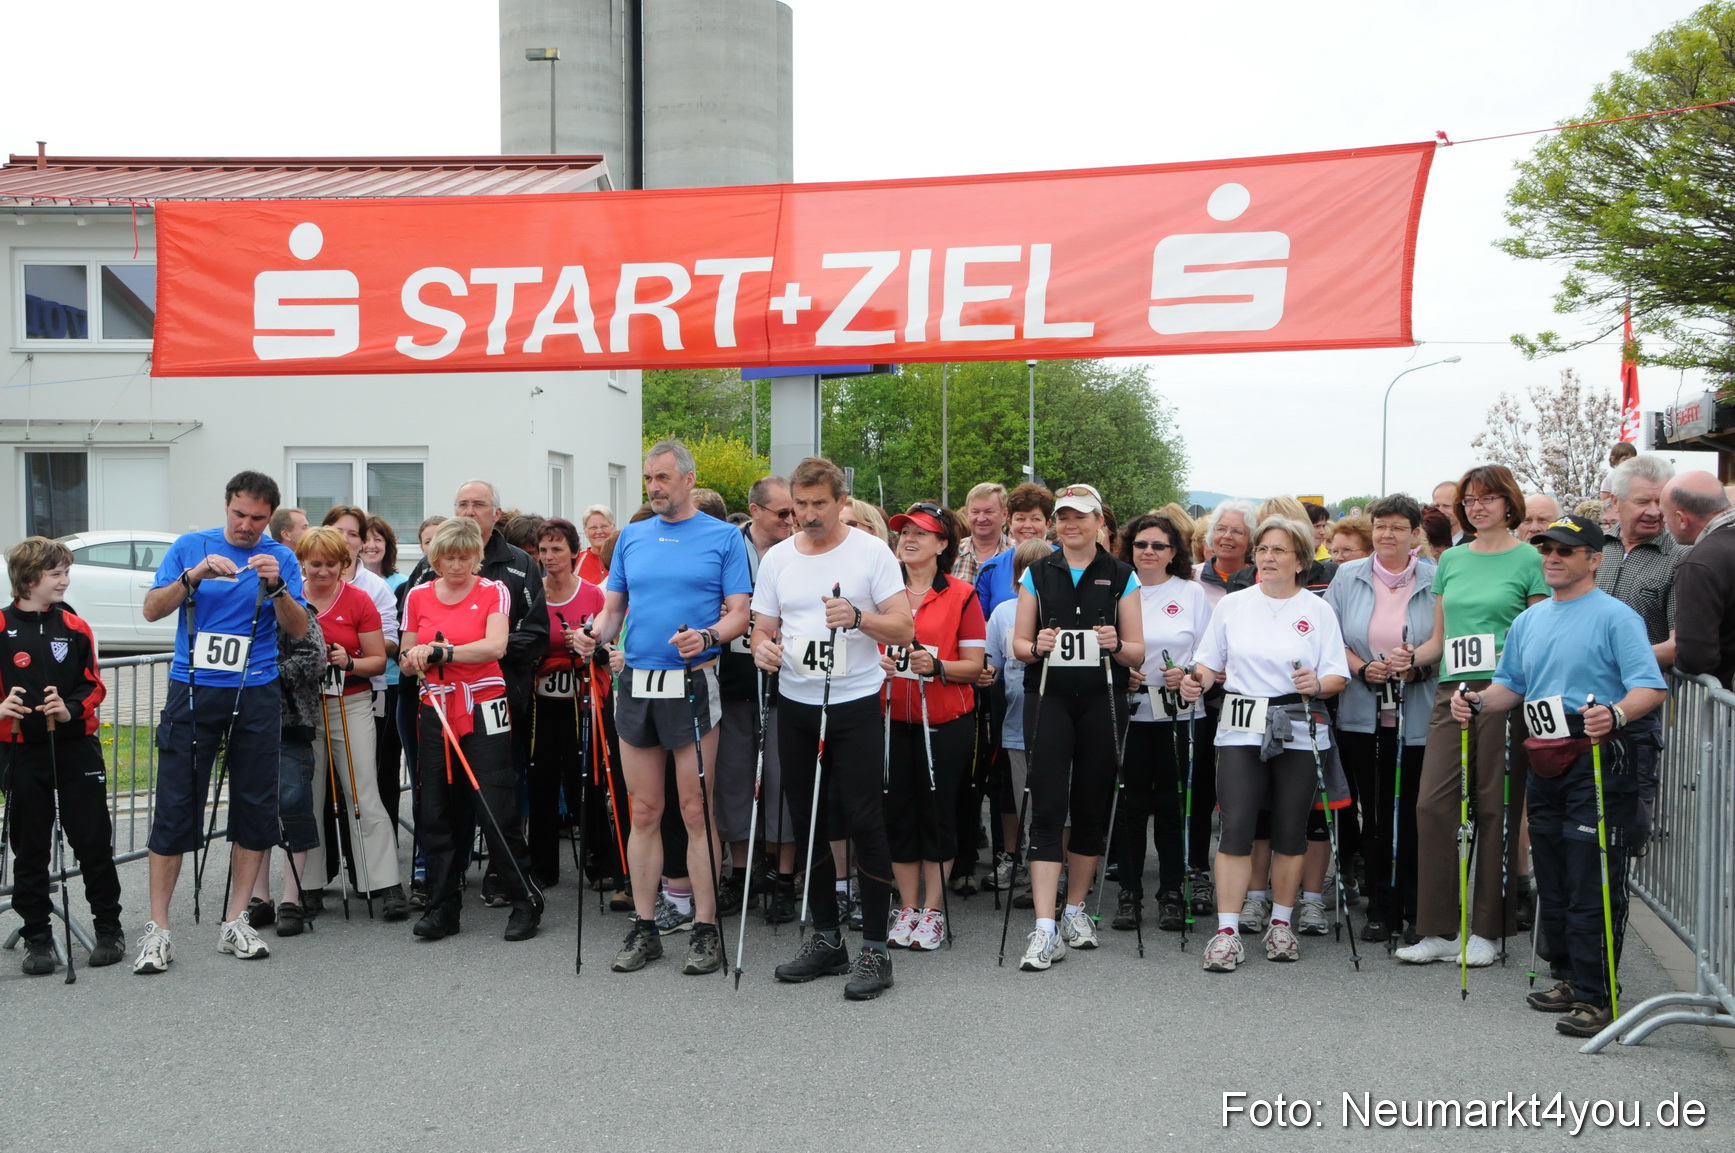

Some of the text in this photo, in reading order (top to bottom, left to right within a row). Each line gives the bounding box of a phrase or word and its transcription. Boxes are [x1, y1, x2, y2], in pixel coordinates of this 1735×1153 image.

[1676, 404, 1700, 427] SEAT
[206, 635, 241, 667] 50
[802, 640, 835, 672] 45
[1061, 631, 1085, 661] 91
[1452, 636, 1482, 669] 119
[544, 670, 571, 694] 30
[1230, 697, 1256, 728] 117
[1526, 700, 1557, 737] 89
